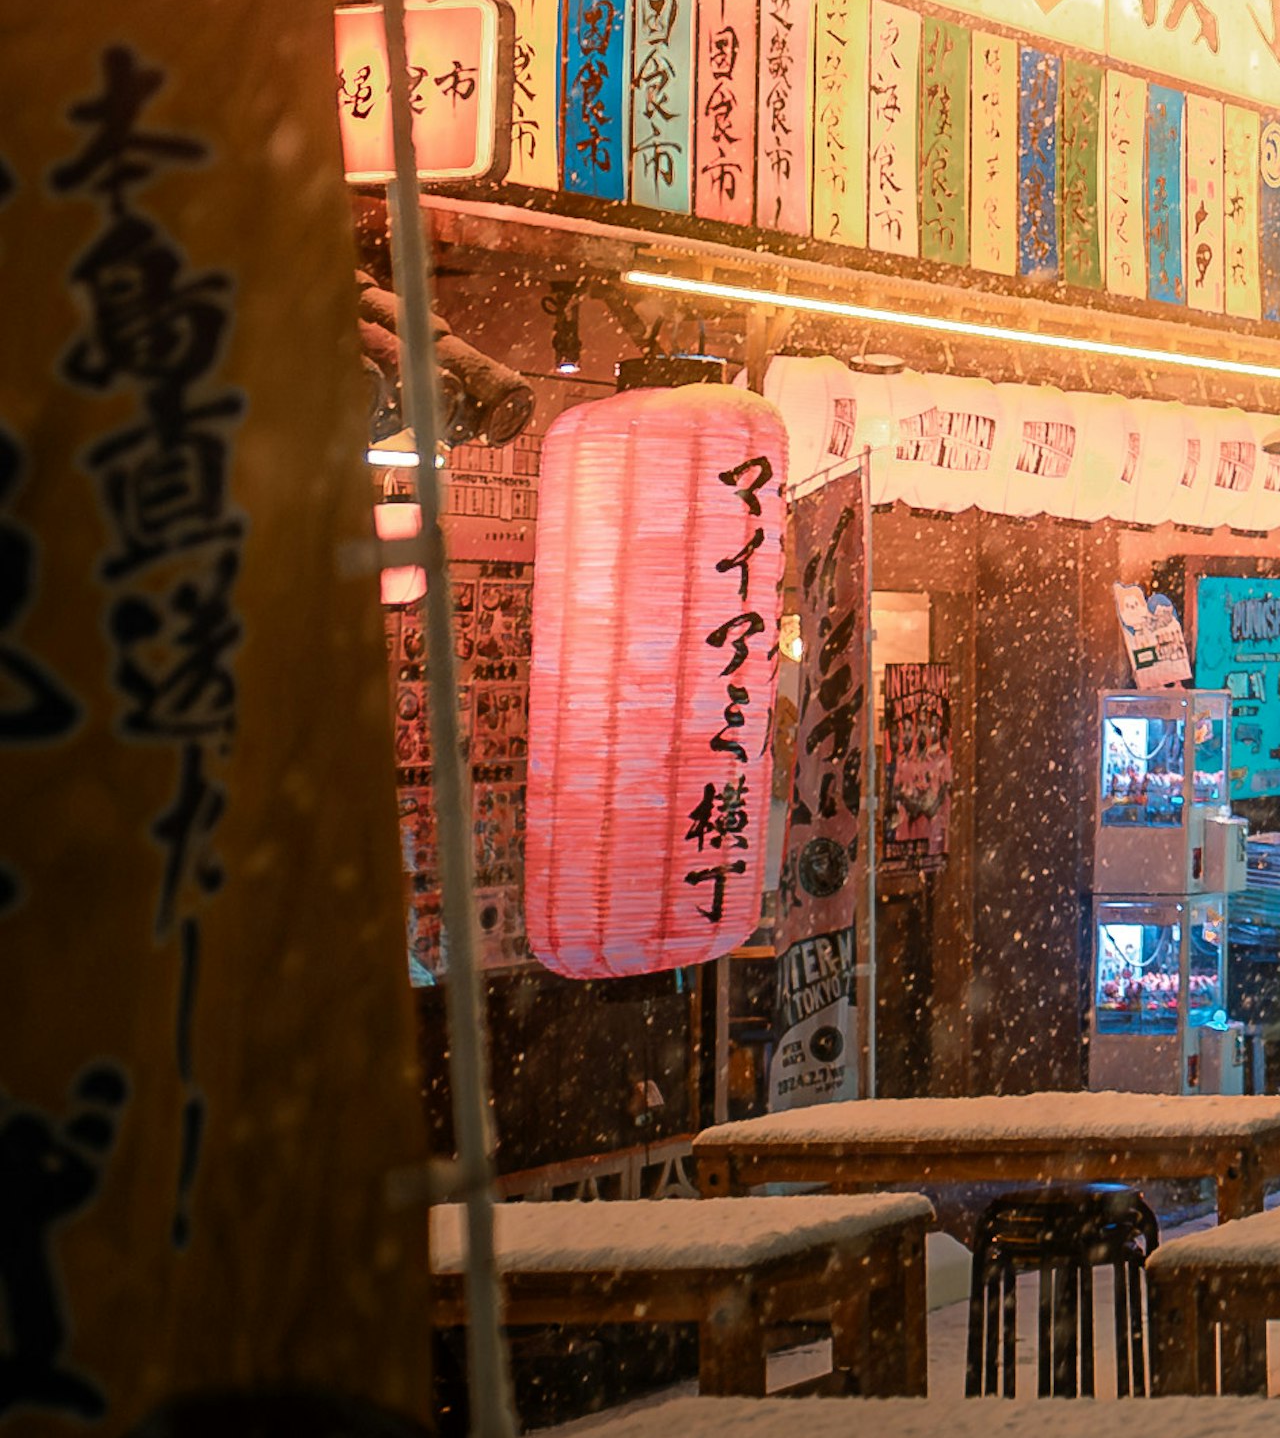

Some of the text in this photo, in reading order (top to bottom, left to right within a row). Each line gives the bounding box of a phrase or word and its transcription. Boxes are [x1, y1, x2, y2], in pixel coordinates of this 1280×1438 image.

[684, 455, 773, 923] マイアミ横丁
